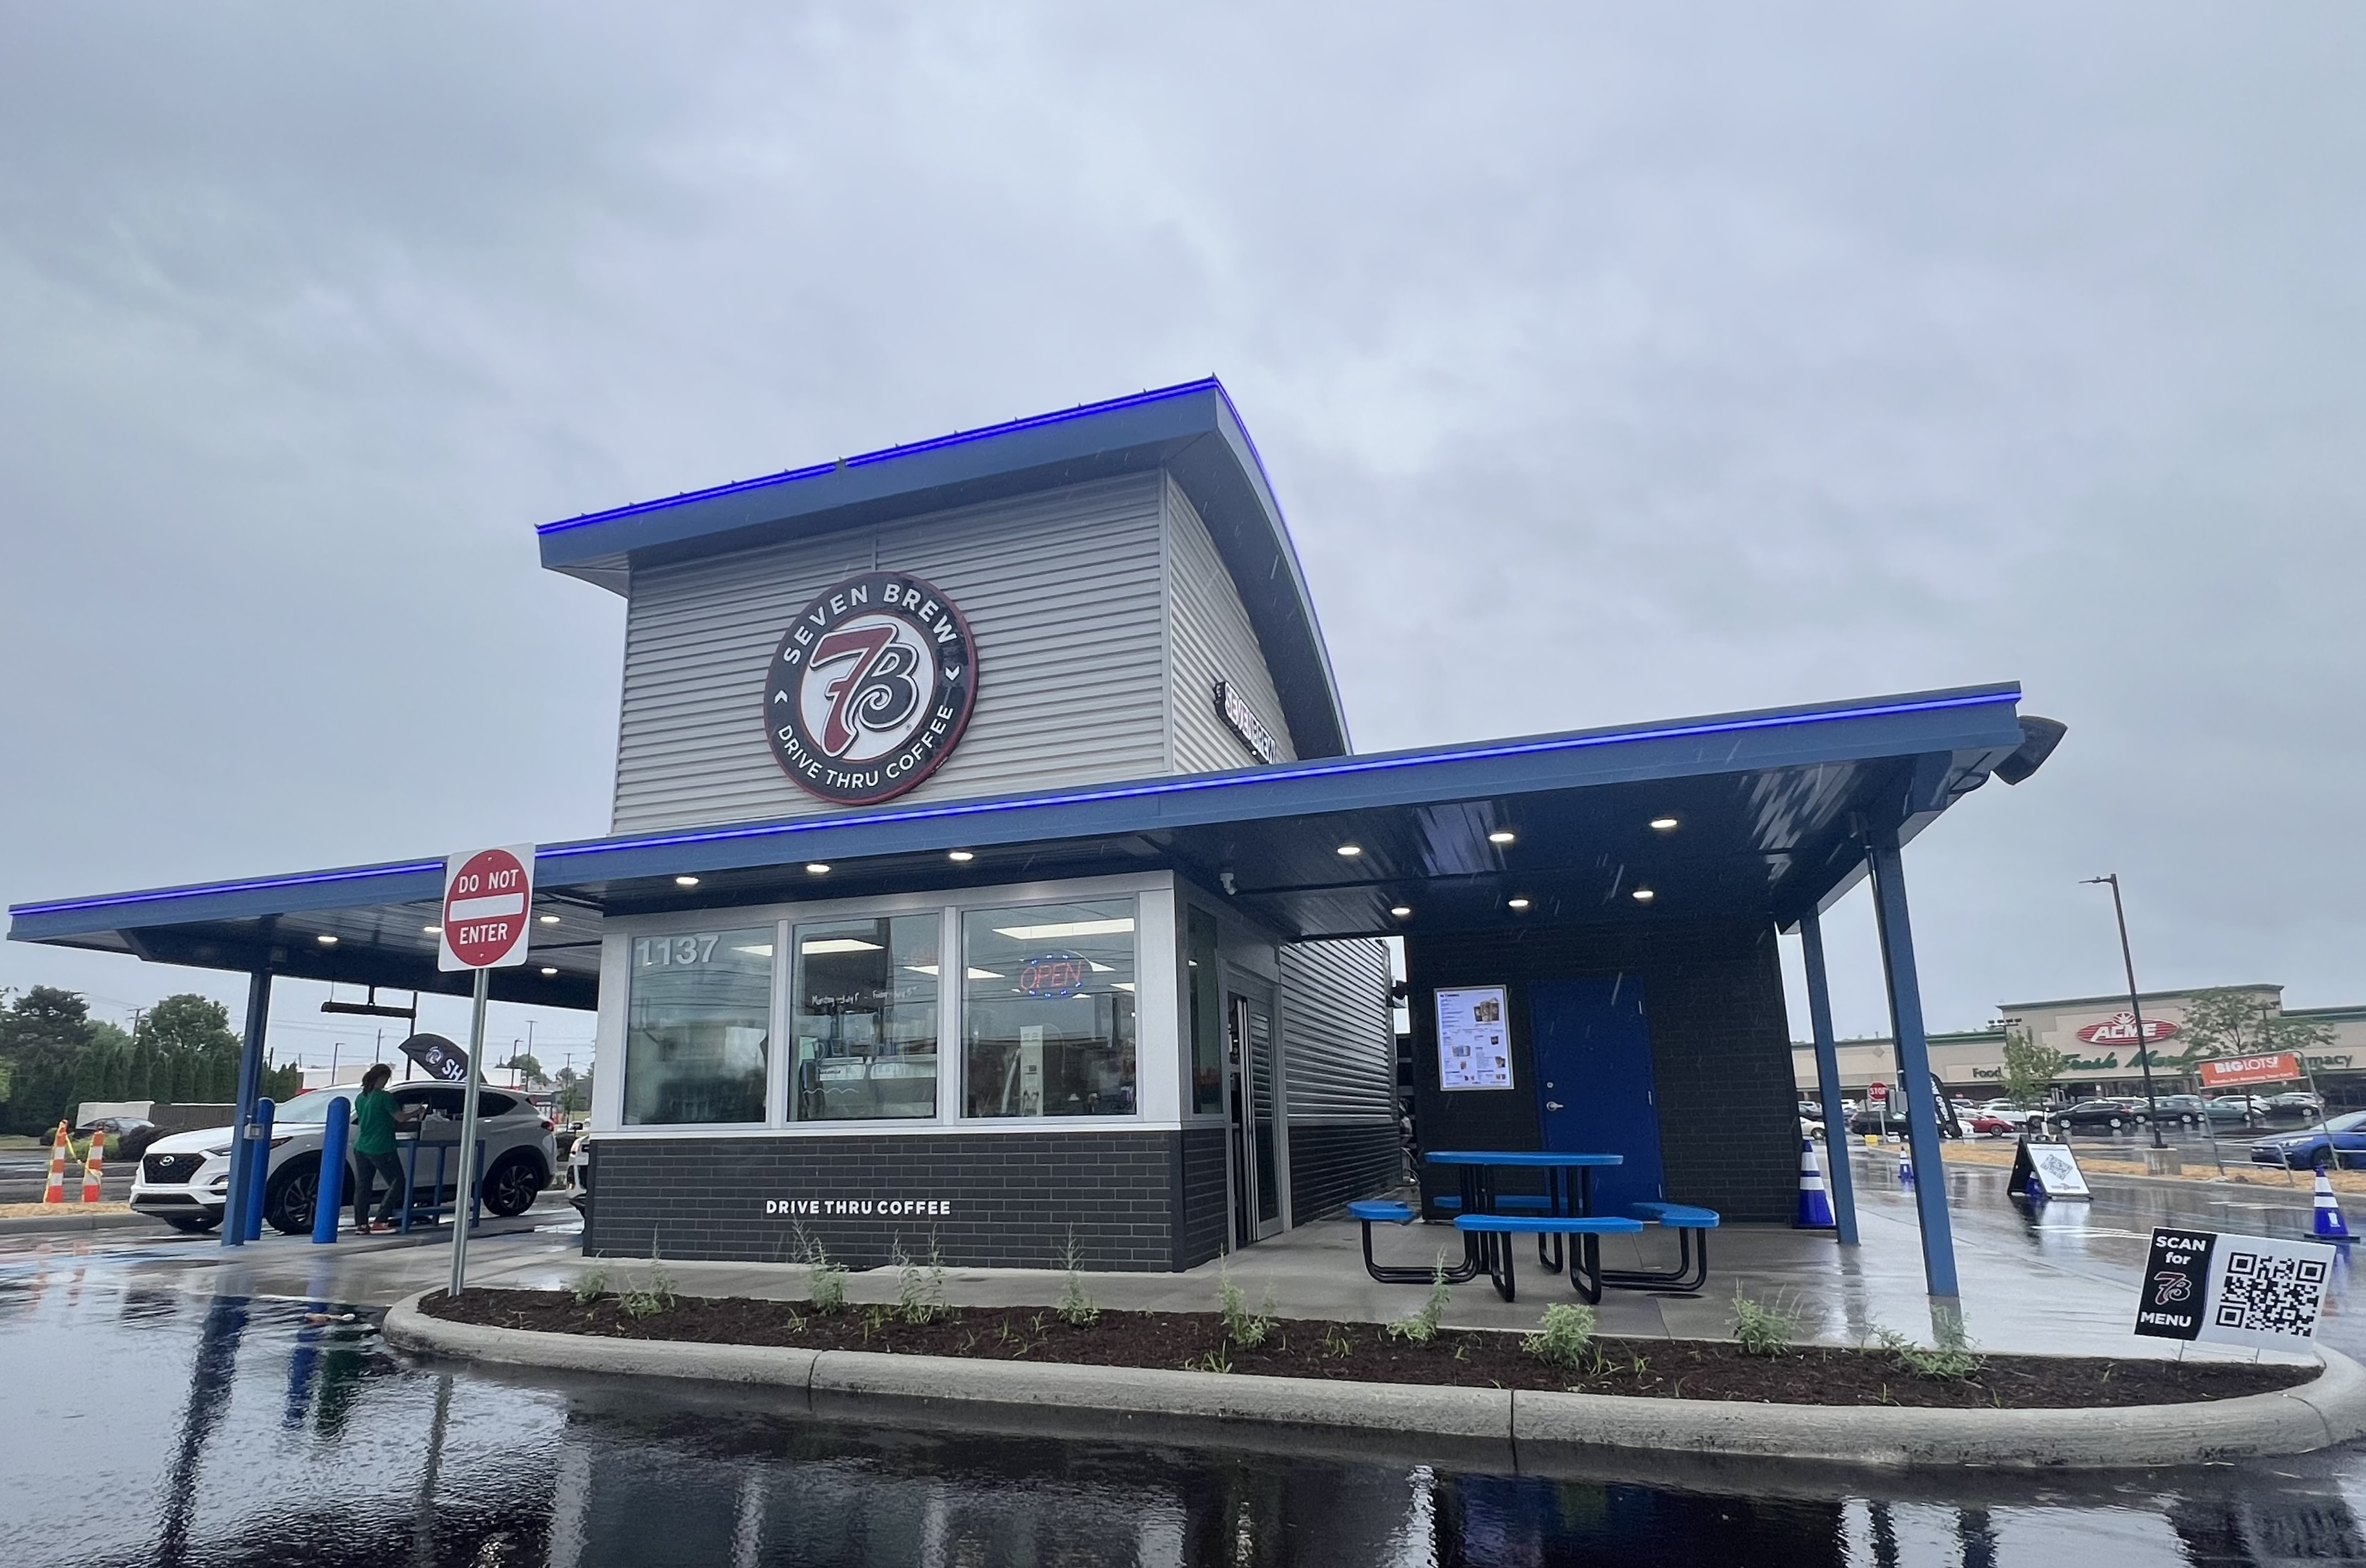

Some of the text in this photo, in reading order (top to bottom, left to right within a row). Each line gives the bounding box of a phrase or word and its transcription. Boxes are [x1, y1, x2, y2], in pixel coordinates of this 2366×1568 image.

[784, 584, 957, 664] SEVEN BREW
[778, 705, 953, 789] DRIVE THRU COFFEE
[458, 869, 519, 893] DO NOT
[459, 923, 508, 945] ENTER
[637, 935, 719, 966] 1137
[1020, 960, 1082, 990] OPEN
[2090, 1023, 2157, 1042] ACME
[1972, 1066, 2002, 1078] Food
[766, 1200, 951, 1215] DRIVE THRU COFFEE
[2155, 1236, 2206, 1251] SCAN
[2165, 1251, 2191, 1265] for
[2140, 1311, 2192, 1327] MENU
